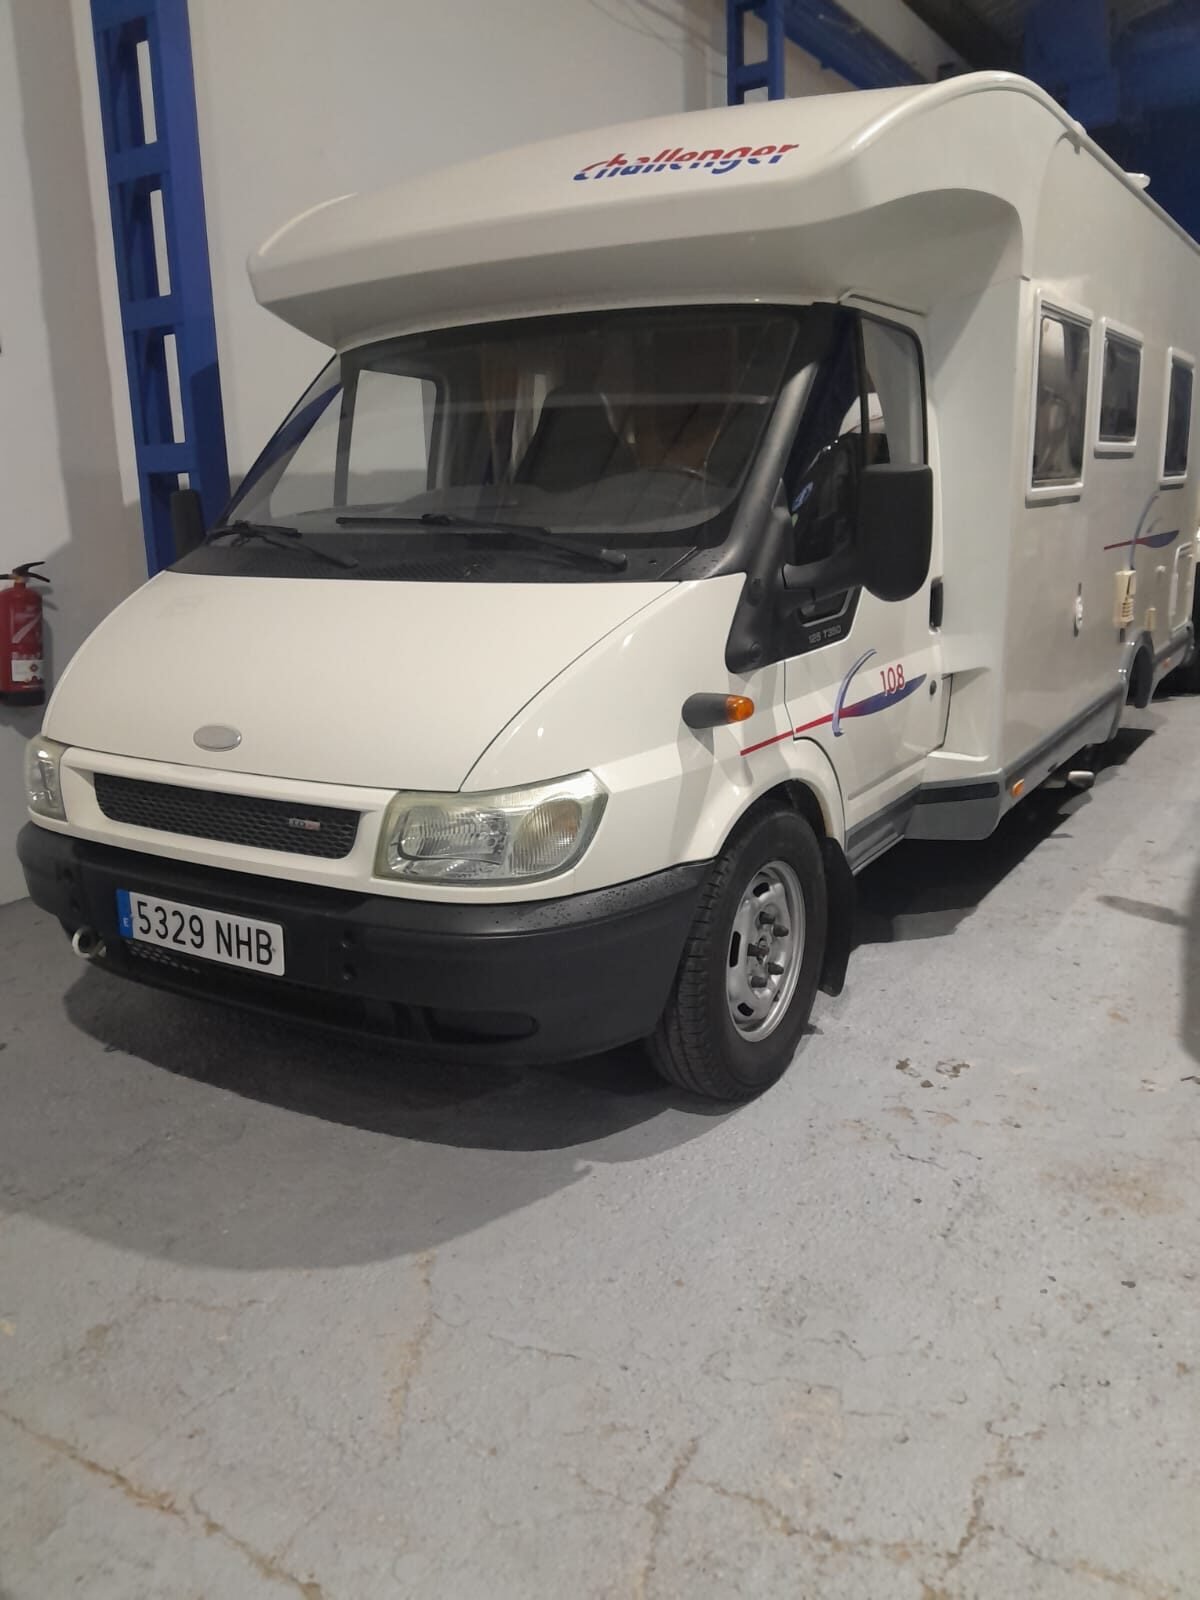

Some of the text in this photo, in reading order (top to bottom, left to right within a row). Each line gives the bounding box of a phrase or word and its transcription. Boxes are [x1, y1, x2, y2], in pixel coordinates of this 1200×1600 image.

[880, 663, 906, 696] 108
[137, 900, 205, 949] 5329
[215, 919, 273, 966] NHB
